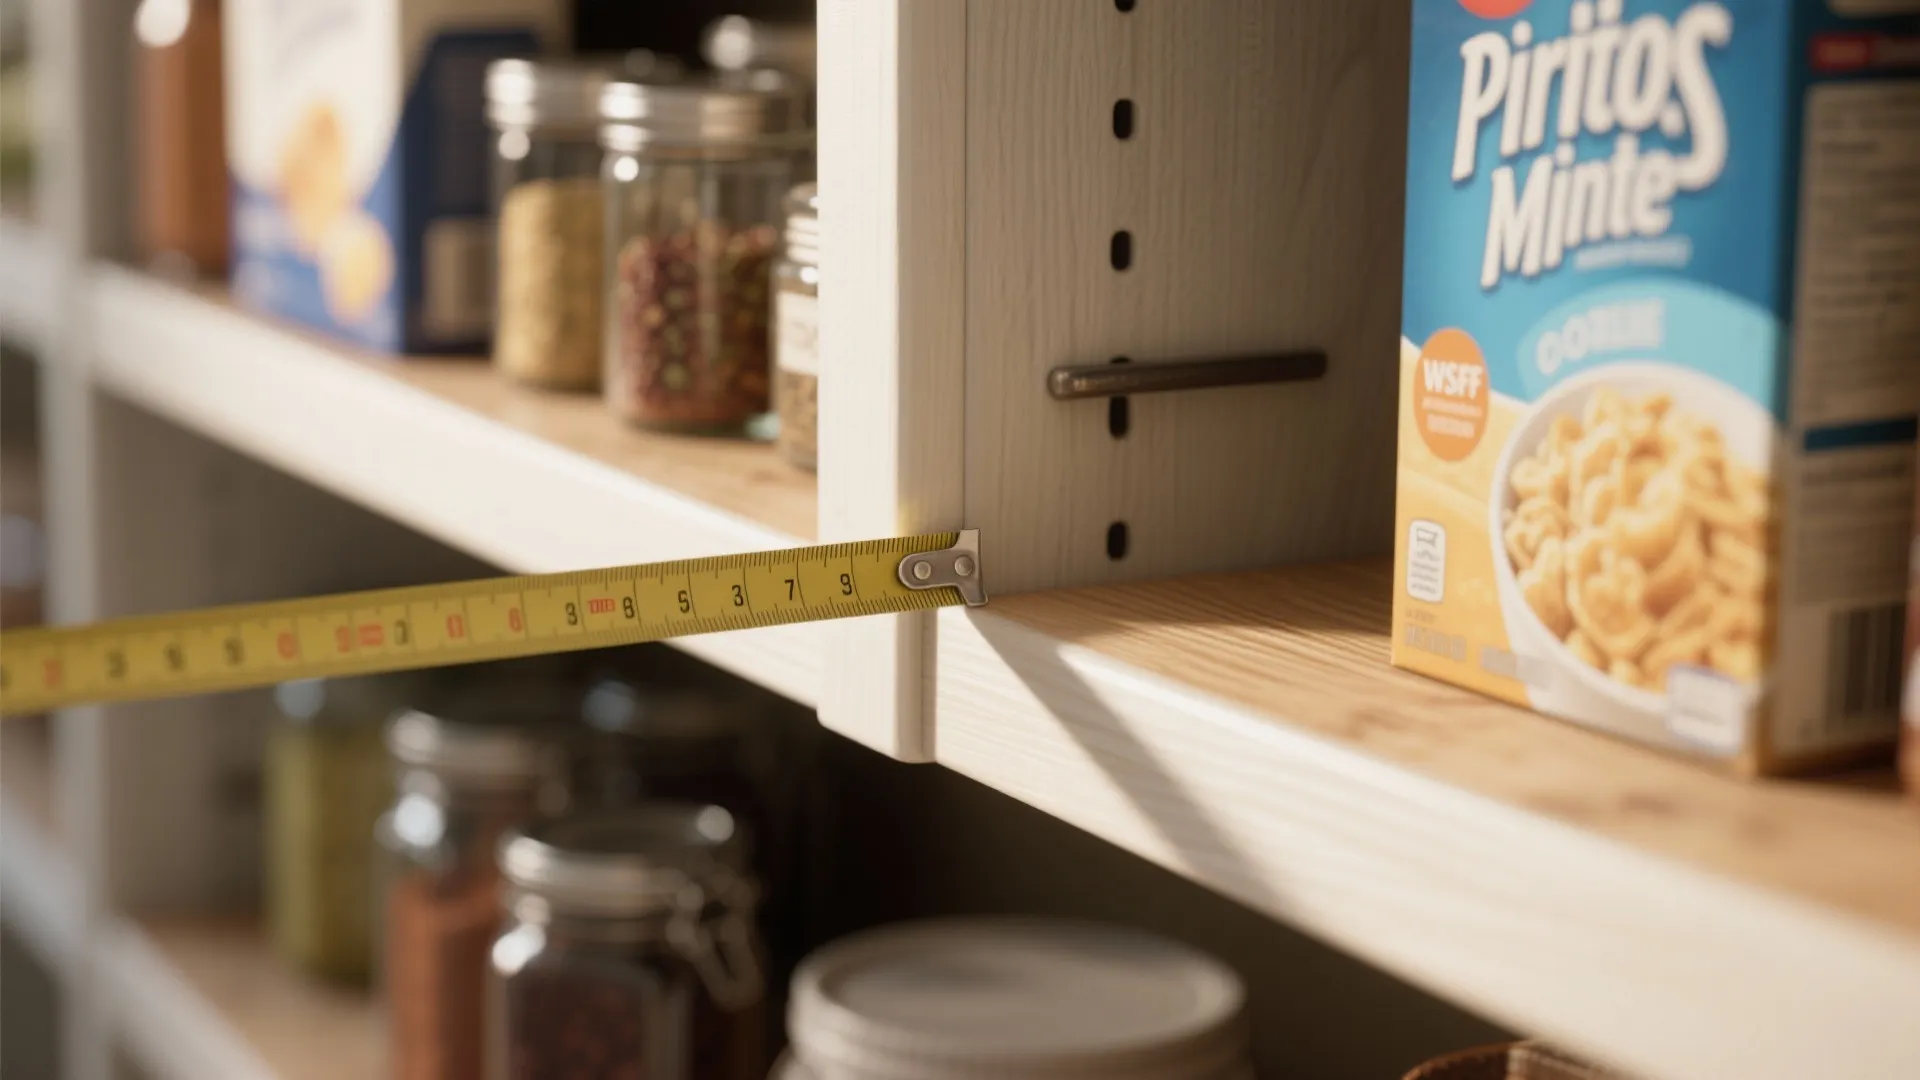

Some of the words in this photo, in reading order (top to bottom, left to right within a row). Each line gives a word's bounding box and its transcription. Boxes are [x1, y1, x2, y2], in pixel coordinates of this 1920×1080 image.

[1480, 132, 1676, 290] Minte
[731, 584, 744, 606] 3
[784, 579, 795, 601] 7
[840, 573, 853, 596] 9
